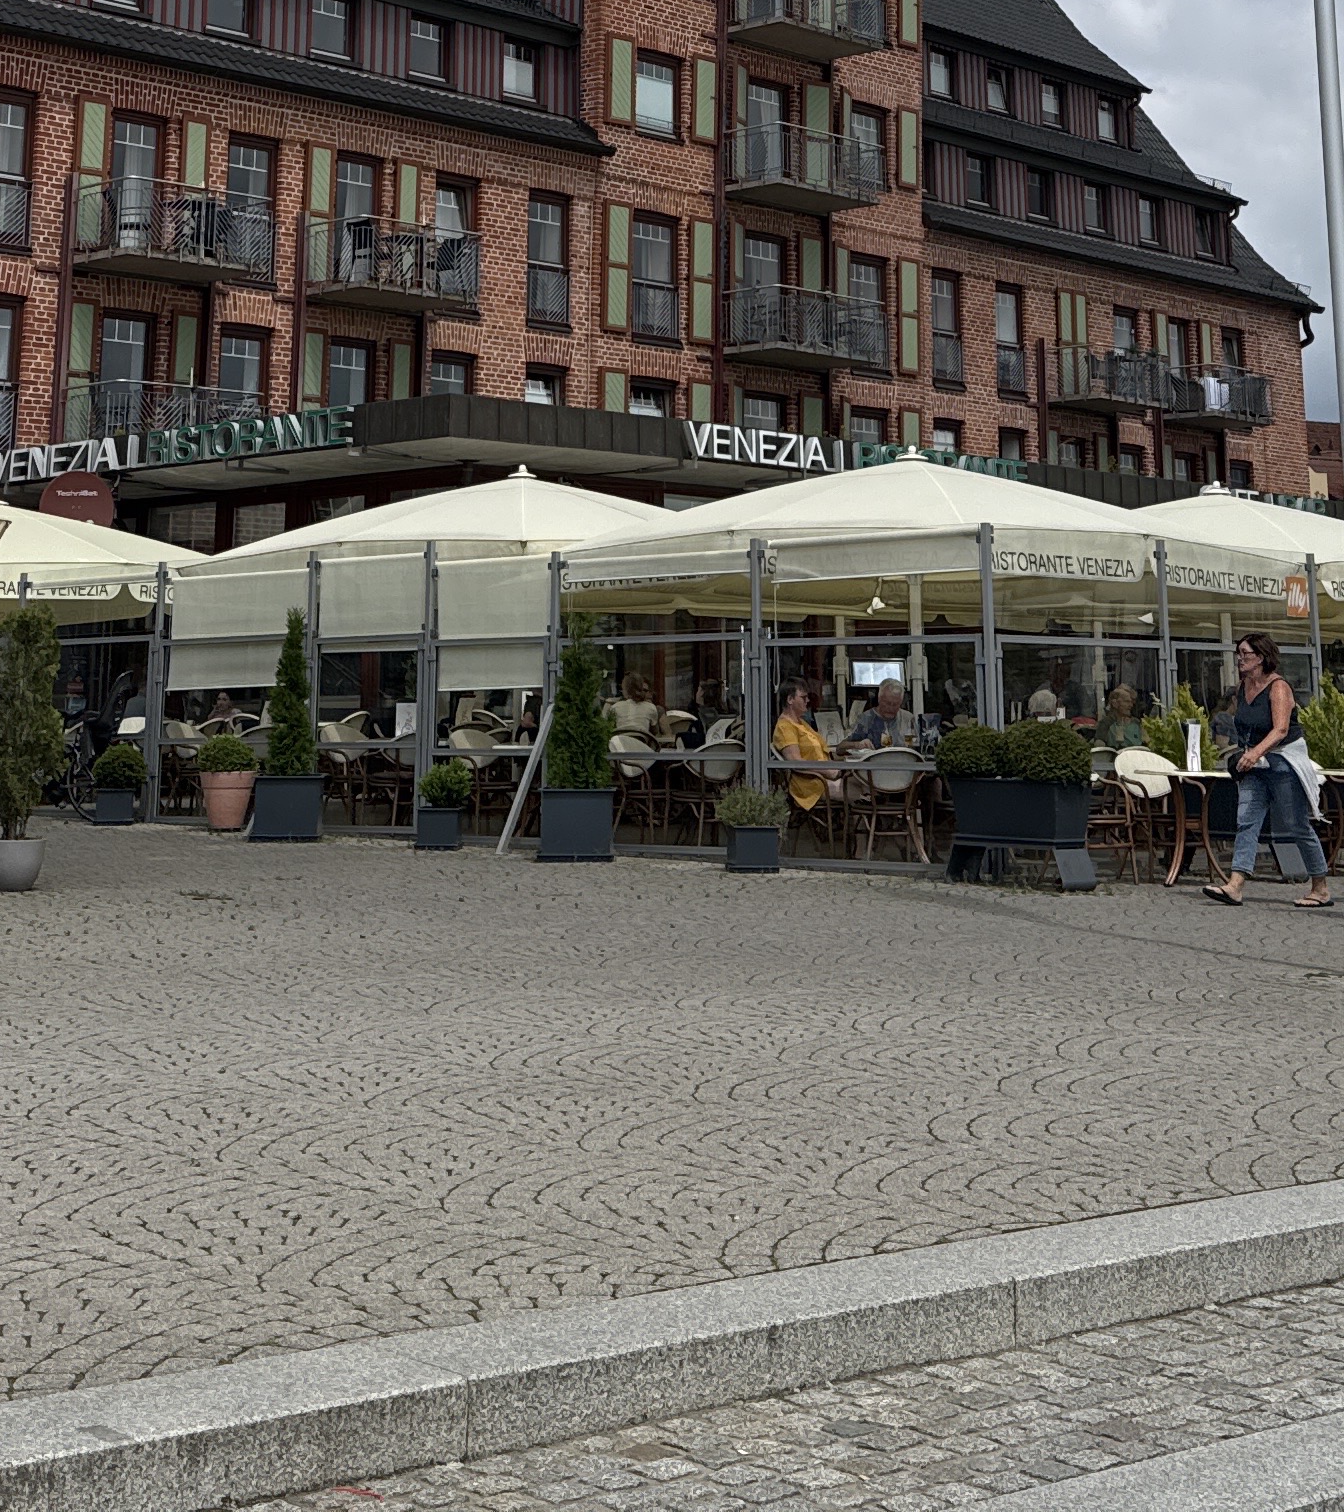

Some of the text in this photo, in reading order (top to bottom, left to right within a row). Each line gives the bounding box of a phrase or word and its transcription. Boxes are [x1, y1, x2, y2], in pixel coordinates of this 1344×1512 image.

[147, 406, 355, 465] RISTORANTE
[685, 420, 828, 472] VENEZIA
[1076, 556, 1136, 578] VENEZIA
[1165, 564, 1287, 597] RISTORANTE VENEZIA
